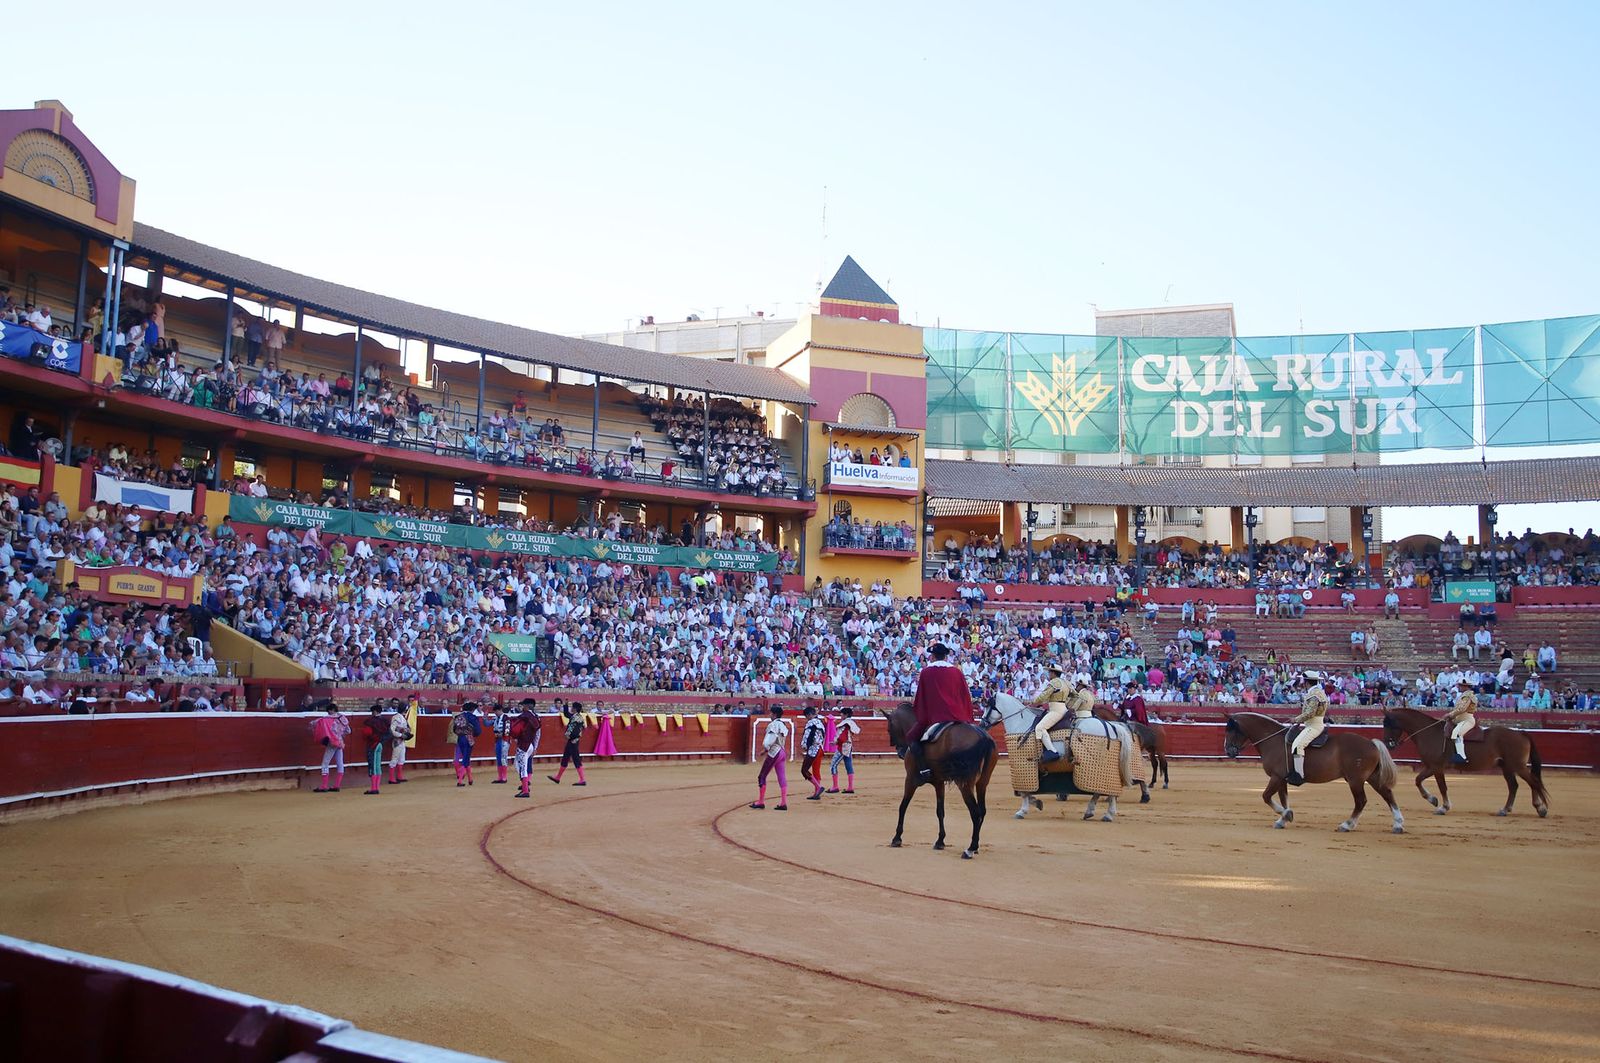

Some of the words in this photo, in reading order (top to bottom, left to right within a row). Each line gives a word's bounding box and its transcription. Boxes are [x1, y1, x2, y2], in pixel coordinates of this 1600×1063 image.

[1131, 353, 1259, 396] CAJA
[1271, 347, 1464, 392] RURAL
[1170, 400, 1282, 438] DEL
[1302, 396, 1423, 439] SUR
[834, 464, 878, 478] Huelva
[879, 473, 916, 482] Información
[275, 504, 300, 516] CAJA
[301, 507, 333, 520] RURAL
[283, 515, 304, 526] DEL
[306, 518, 326, 529] SUR
[395, 520, 417, 530] CAJA
[418, 522, 449, 534] RURAL
[401, 530, 421, 540] DEL
[423, 532, 442, 542] SUR
[505, 532, 527, 542] CAJA
[528, 535, 557, 545] RURAL
[512, 542, 530, 551] DEL
[532, 543, 551, 553] SUR
[611, 543, 632, 553] CAJA
[632, 545, 660, 555] RURAL
[616, 552, 635, 561] DEL
[636, 554, 655, 563] SUR
[713, 552, 733, 561] CAJA
[734, 553, 762, 563] RURAL
[719, 560, 736, 569] DEL
[737, 561, 756, 570] SUR
